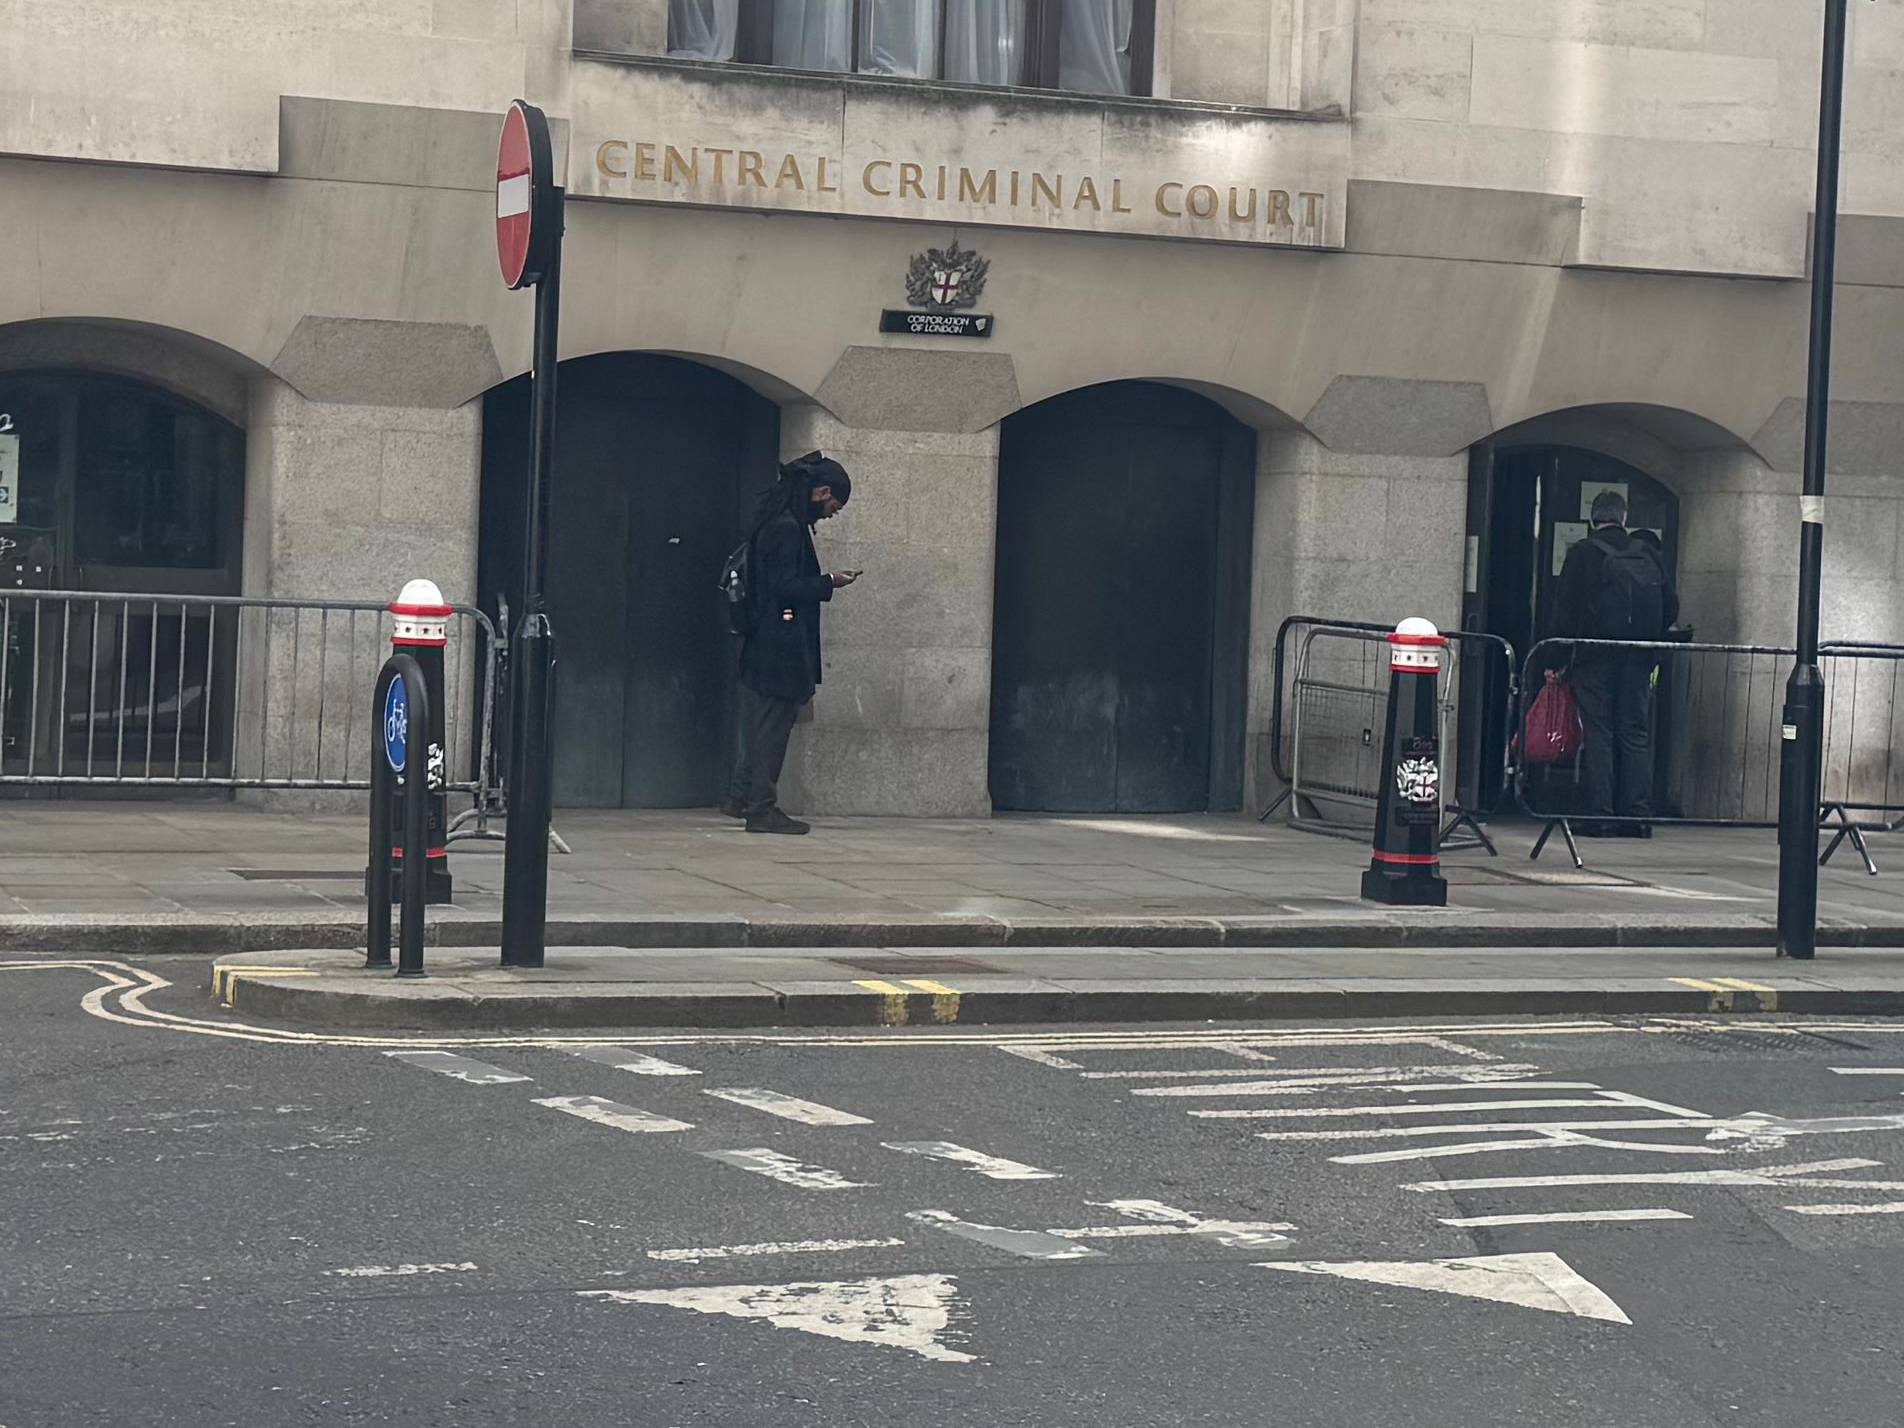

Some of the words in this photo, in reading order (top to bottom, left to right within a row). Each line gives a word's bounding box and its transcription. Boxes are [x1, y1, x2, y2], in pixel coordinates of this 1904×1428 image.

[596, 139, 837, 193] CENTRAL
[862, 160, 1132, 214] CRIMINAL
[1155, 182, 1324, 228] COURT
[907, 315, 969, 326] CORPORATION
[910, 323, 923, 332] OF
[924, 324, 963, 334] LONDON
